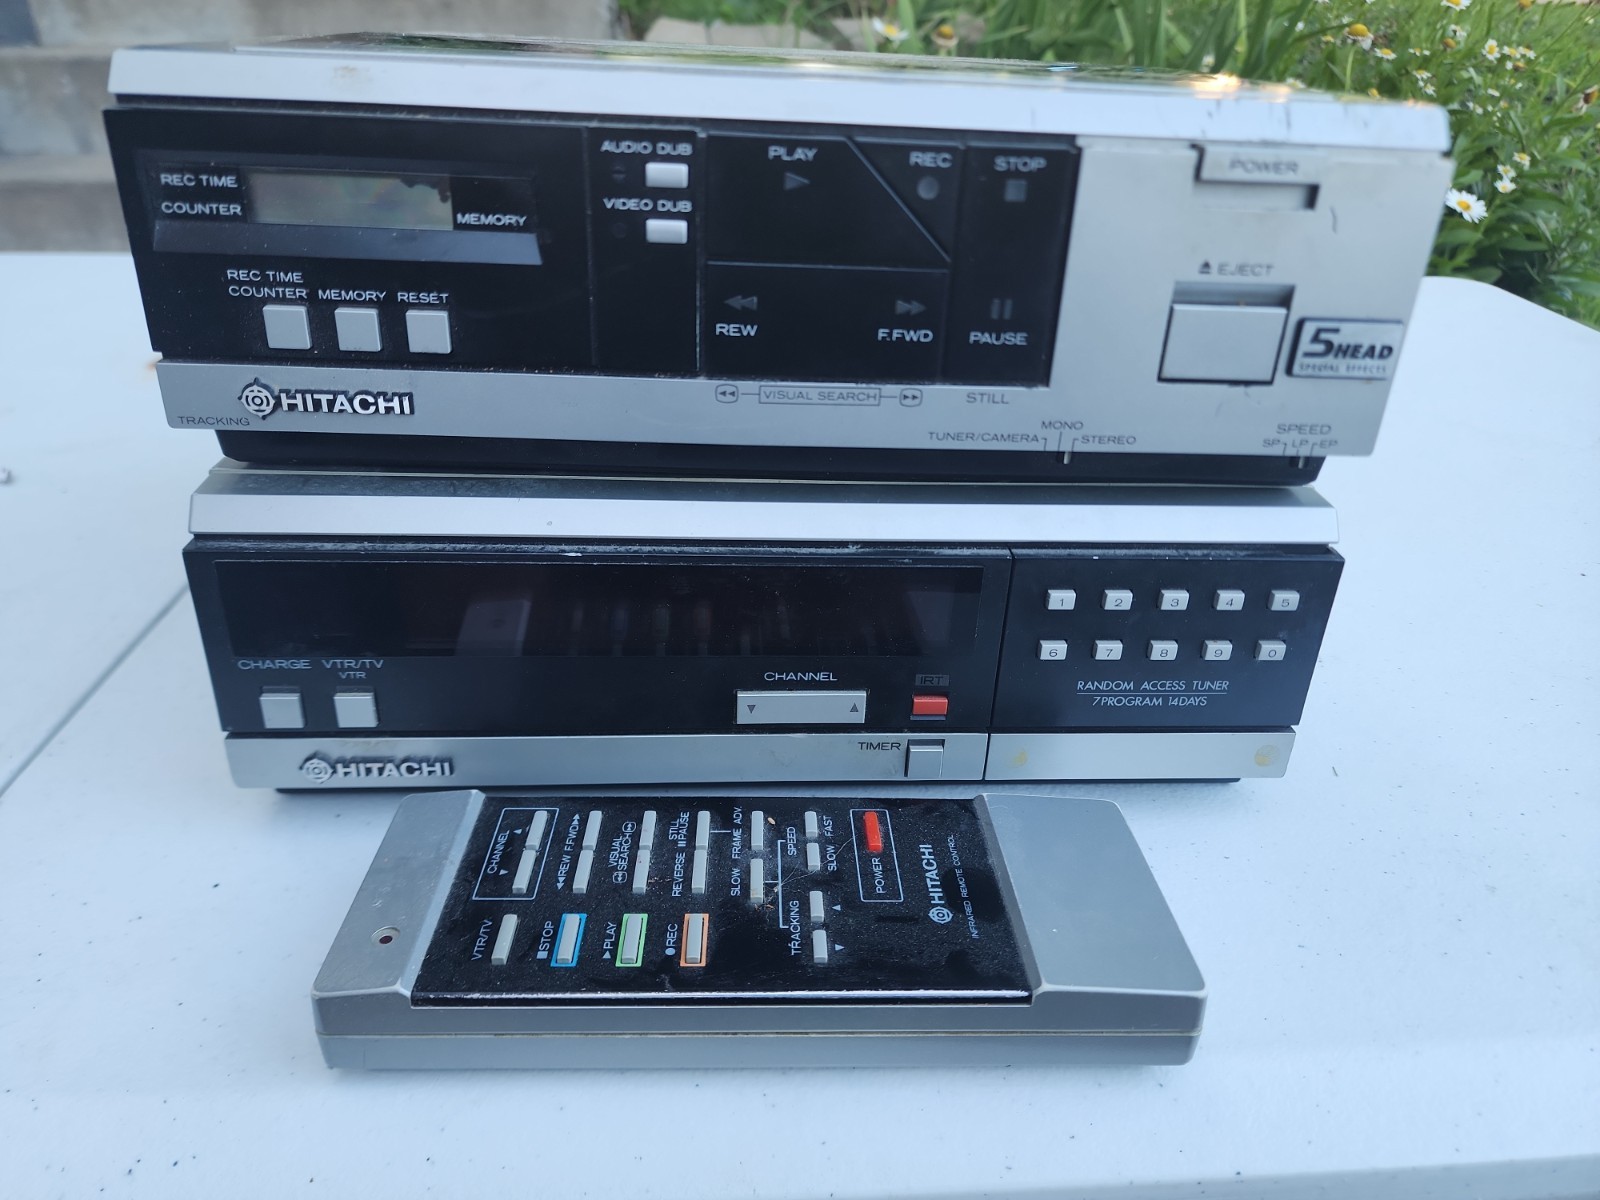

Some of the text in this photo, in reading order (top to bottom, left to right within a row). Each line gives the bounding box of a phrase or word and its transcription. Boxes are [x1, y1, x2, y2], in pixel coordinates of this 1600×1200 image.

[600, 140, 693, 156] AUDIO DUB
[768, 145, 818, 162] PLAY
[909, 151, 953, 169] REC
[994, 155, 1047, 173] STOP
[1229, 159, 1299, 175] POWER
[160, 173, 239, 189] REC TIME
[161, 201, 242, 216] COUNTER
[603, 197, 693, 213] VIDEO DUB
[456, 212, 527, 228] MEMORY
[226, 269, 304, 284] REC TIME
[1217, 263, 1274, 277] EJECT
[228, 285, 308, 300] COUNTER
[318, 288, 387, 302] MEMORY
[397, 291, 450, 304] RESET
[715, 322, 758, 338] REW
[877, 328, 934, 344] F.FWD
[969, 331, 1028, 346] PAUSE
[1299, 362, 1388, 376] SPECIAL EFFECTS
[279, 388, 414, 416] HITACHI
[763, 389, 879, 403] VISUAL SEARCH
[965, 392, 1009, 405] STILL
[177, 415, 250, 427] TRACKING
[1041, 420, 1084, 431] MONO
[1276, 423, 1332, 436] SPEED
[928, 431, 1040, 444] TUNER/CAMERA
[1081, 434, 1137, 445] STEREO
[1263, 438, 1281, 449] SP
[1292, 439, 1309, 450] LP
[1319, 439, 1338, 450] EP
[1058, 597, 1065, 607] 1
[1113, 598, 1123, 608] 2
[1170, 598, 1180, 608] 3
[1225, 598, 1234, 608] 4
[1281, 598, 1290, 608] 5
[1048, 648, 1058, 658] 6
[1105, 648, 1114, 658] 7
[1159, 648, 1169, 658] 8
[1214, 648, 1223, 658] 9
[237, 659, 312, 670] CHARGE
[321, 659, 385, 670] VTR/TV
[339, 671, 367, 680] VTR
[763, 671, 838, 682] CHANNEL
[919, 675, 944, 685] IRT
[1076, 680, 1230, 691] RANDOM ACCESS TUNER
[858, 741, 902, 751] TIMER
[334, 760, 453, 778] HITACHI
[668, 818, 680, 840] STILL
[677, 811, 690, 840] PAUSE
[824, 814, 833, 837] FAST
[731, 827, 742, 859] FRAME
[787, 826, 797, 856] SPEED
[487, 829, 510, 875] CHANNEL
[608, 835, 623, 868] VISUAL
[618, 832, 633, 871] SEARCH
[827, 845, 837, 871] SLOW
[557, 854, 572, 877] REW
[671, 851, 686, 897] REVERSE
[872, 857, 886, 894] POWER
[919, 844, 944, 904] HITACHI
[730, 868, 741, 897] SLOW
[949, 834, 980, 939] INFRARED REMOTE CONTROL
[539, 920, 555, 951] STOP
[791, 900, 803, 956] TRACKING
[471, 920, 493, 961] VTR/TV
[603, 921, 617, 951] PLAY
[666, 923, 678, 950] REC
